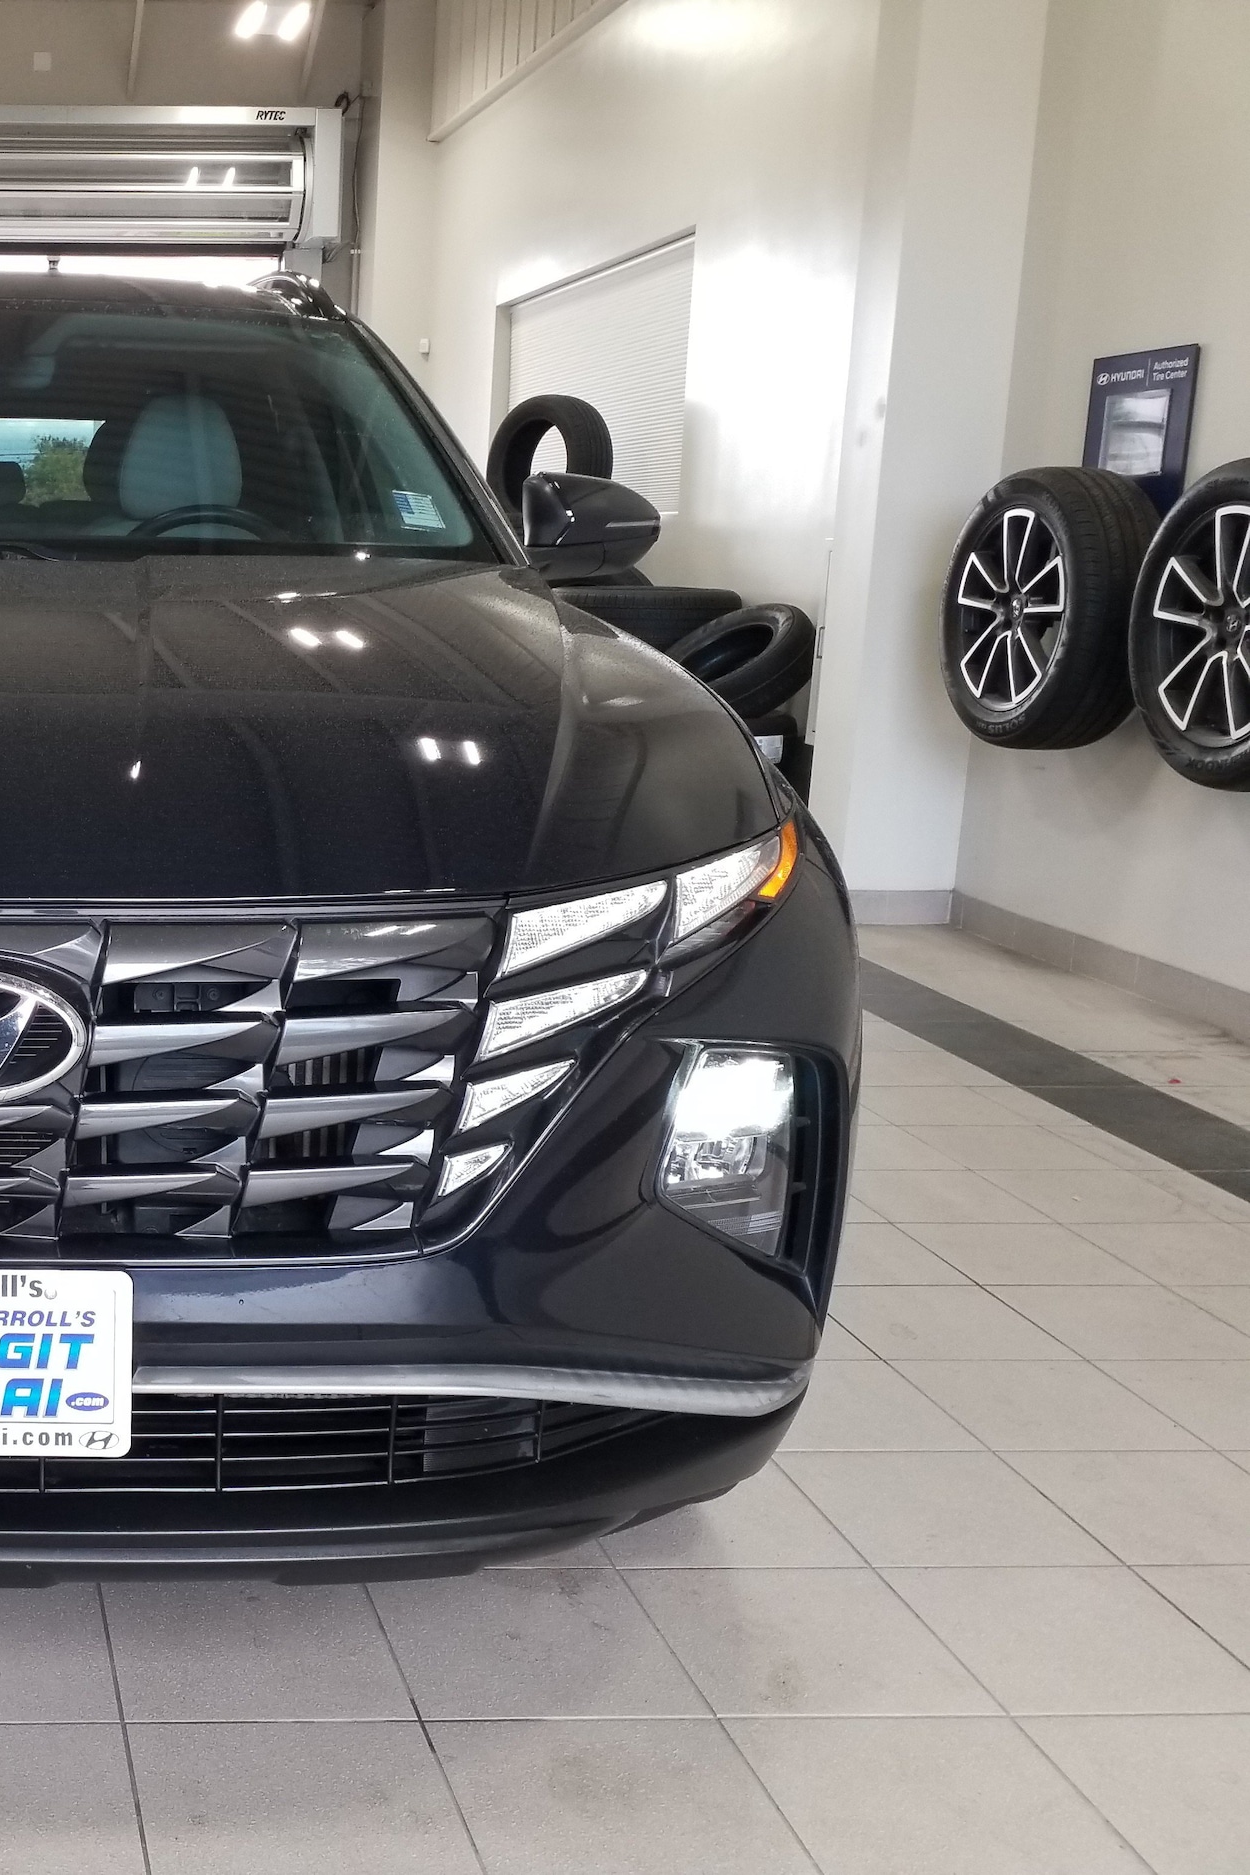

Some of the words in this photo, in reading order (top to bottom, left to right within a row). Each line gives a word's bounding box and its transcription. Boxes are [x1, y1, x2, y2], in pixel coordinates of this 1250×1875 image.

[255, 110, 286, 121] RYTEC
[1153, 358, 1189, 370] Authorized
[1110, 369, 1144, 382] HYUNDAI
[1165, 370, 1188, 380] Center
[70, 1394, 105, 1408] .com
